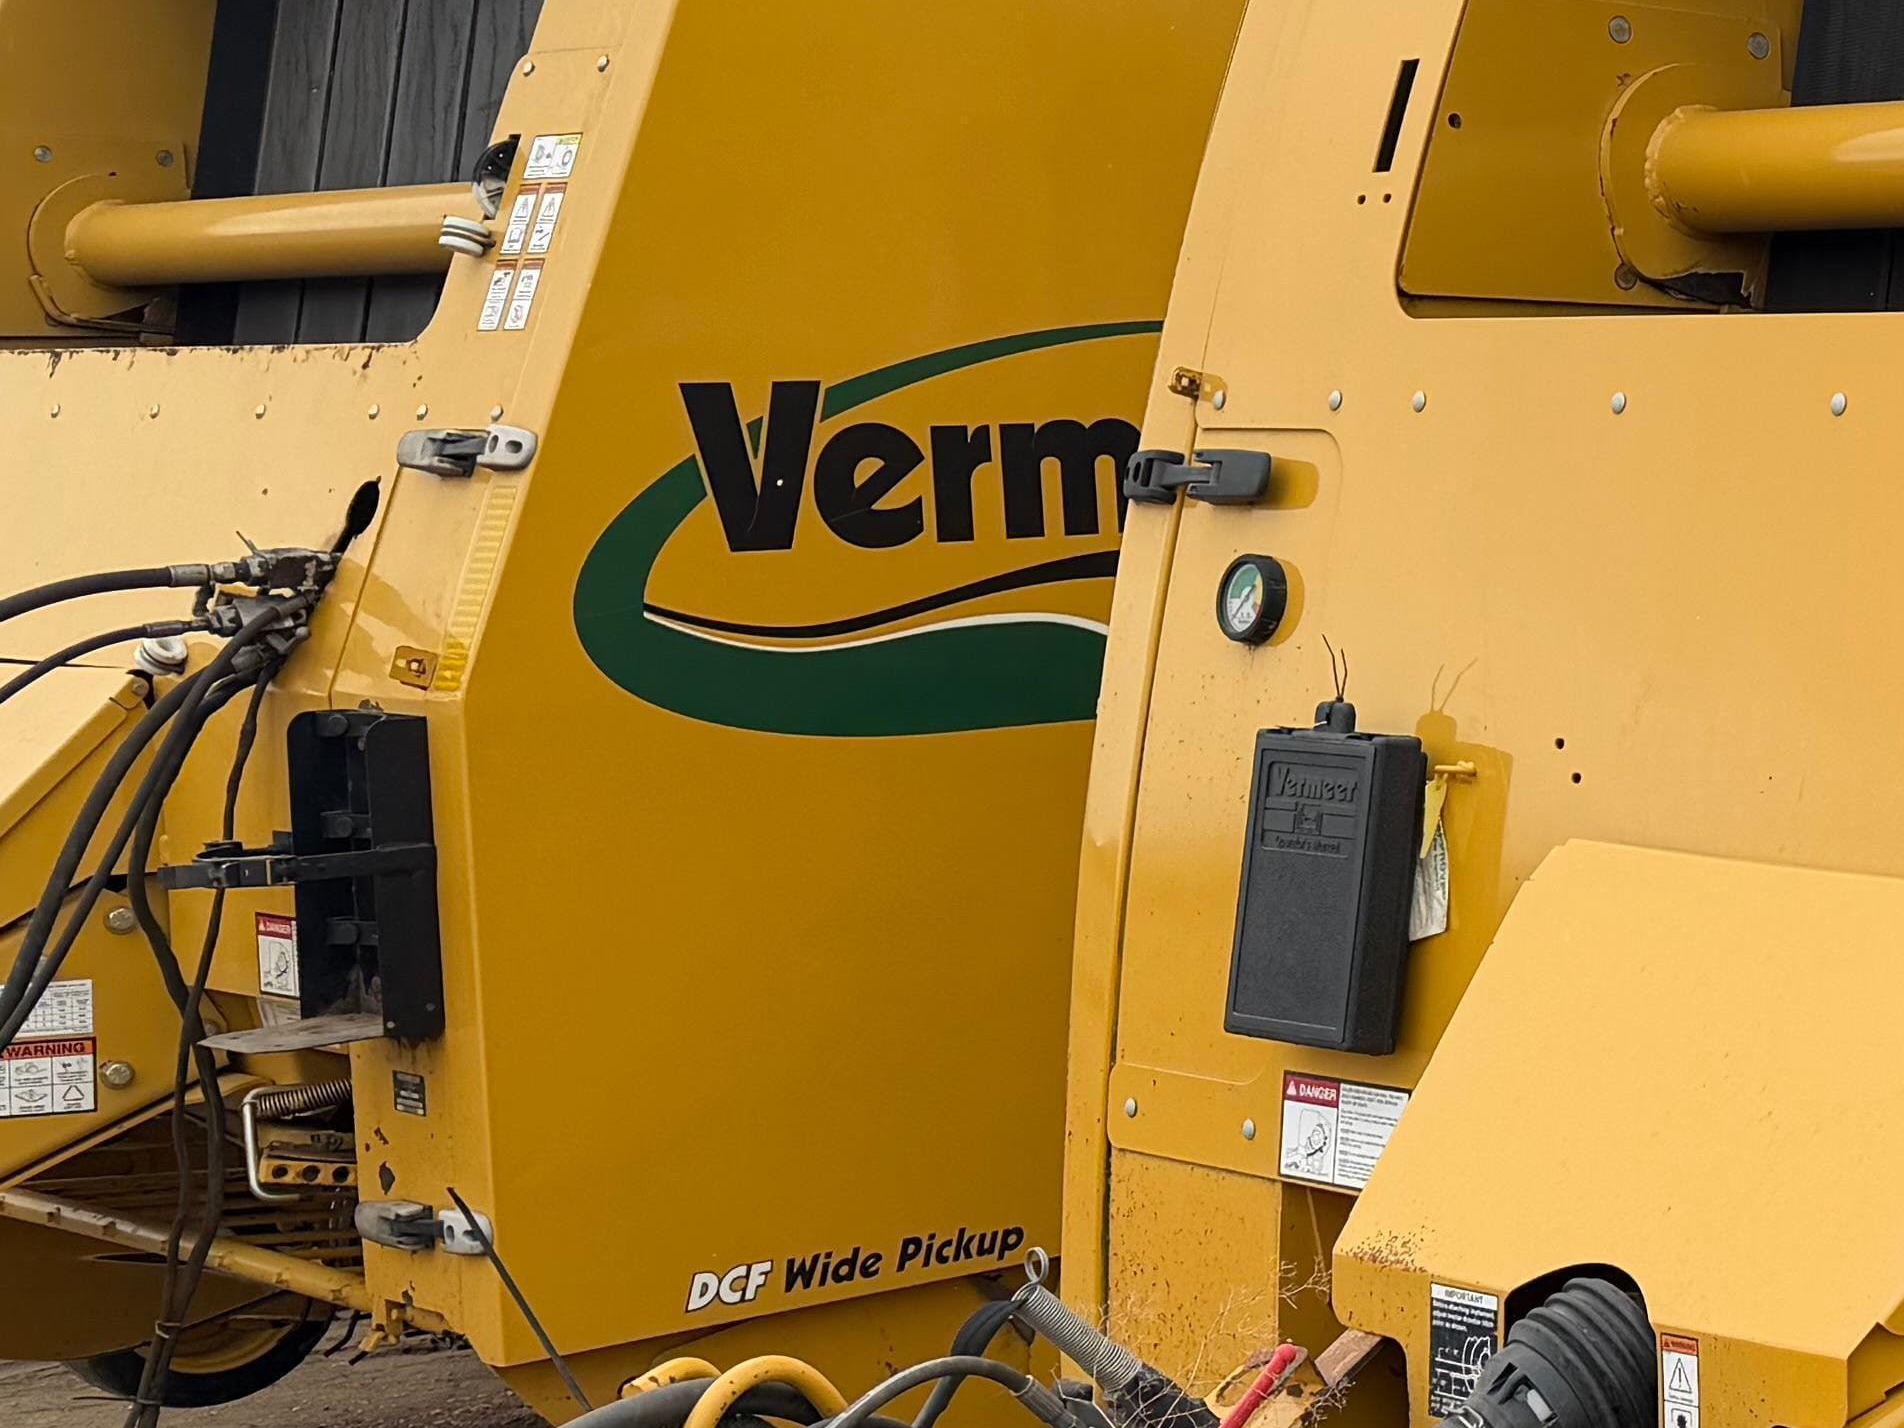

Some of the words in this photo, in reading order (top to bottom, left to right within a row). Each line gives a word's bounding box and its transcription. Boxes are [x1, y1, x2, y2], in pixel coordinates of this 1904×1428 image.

[6, 1042, 86, 1058] WARNING
[1300, 1083, 1338, 1101] DANGER
[685, 1259, 773, 1312] DCF
[784, 1247, 883, 1293] Wide
[896, 1225, 1025, 1273] Pickup
